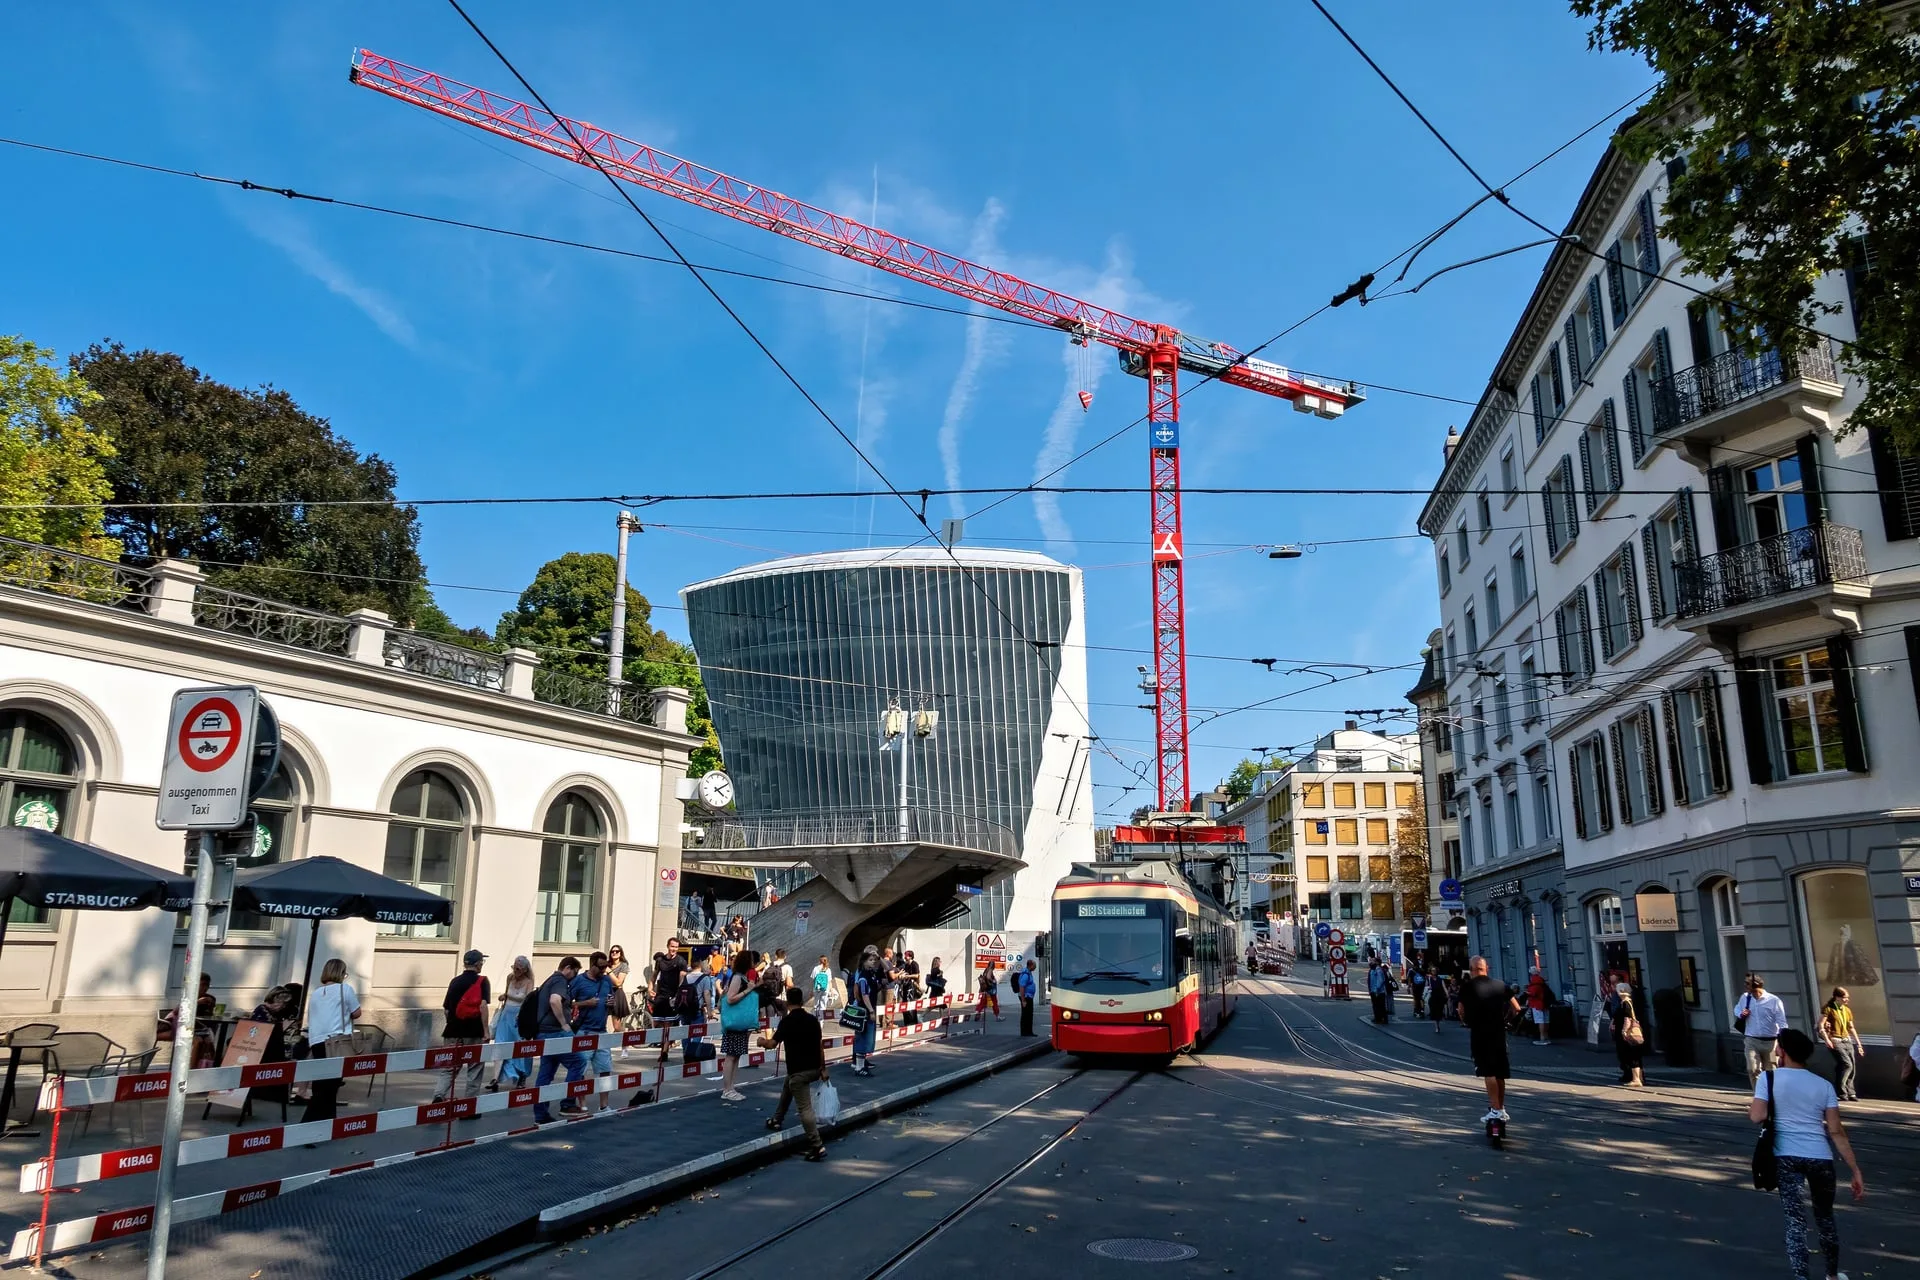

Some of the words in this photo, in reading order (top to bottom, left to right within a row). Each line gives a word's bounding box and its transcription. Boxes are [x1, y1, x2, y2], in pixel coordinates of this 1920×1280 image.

[168, 787, 237, 800] ausgenommen
[191, 803, 210, 815] Taxi
[44, 892, 139, 908] STARBUCKS
[258, 902, 339, 917] STARBUCKS
[1080, 906, 1096, 916] S18
[1097, 906, 1145, 915] Stadelhofen
[375, 910, 433, 923] STARBUCKS
[1641, 916, 1676, 925] Läderach
[434, 1052, 453, 1063] KIBAG
[354, 1059, 377, 1070] KIBAG
[255, 1068, 283, 1081] KIBAG
[134, 1079, 167, 1093] KIBAG
[427, 1107, 446, 1118] KIBAG
[344, 1119, 367, 1132] KIBAG
[243, 1135, 271, 1149] KIBAG
[119, 1153, 153, 1169] KIBAG
[238, 1189, 267, 1204] KIBAG
[112, 1214, 147, 1231] KIBAG
